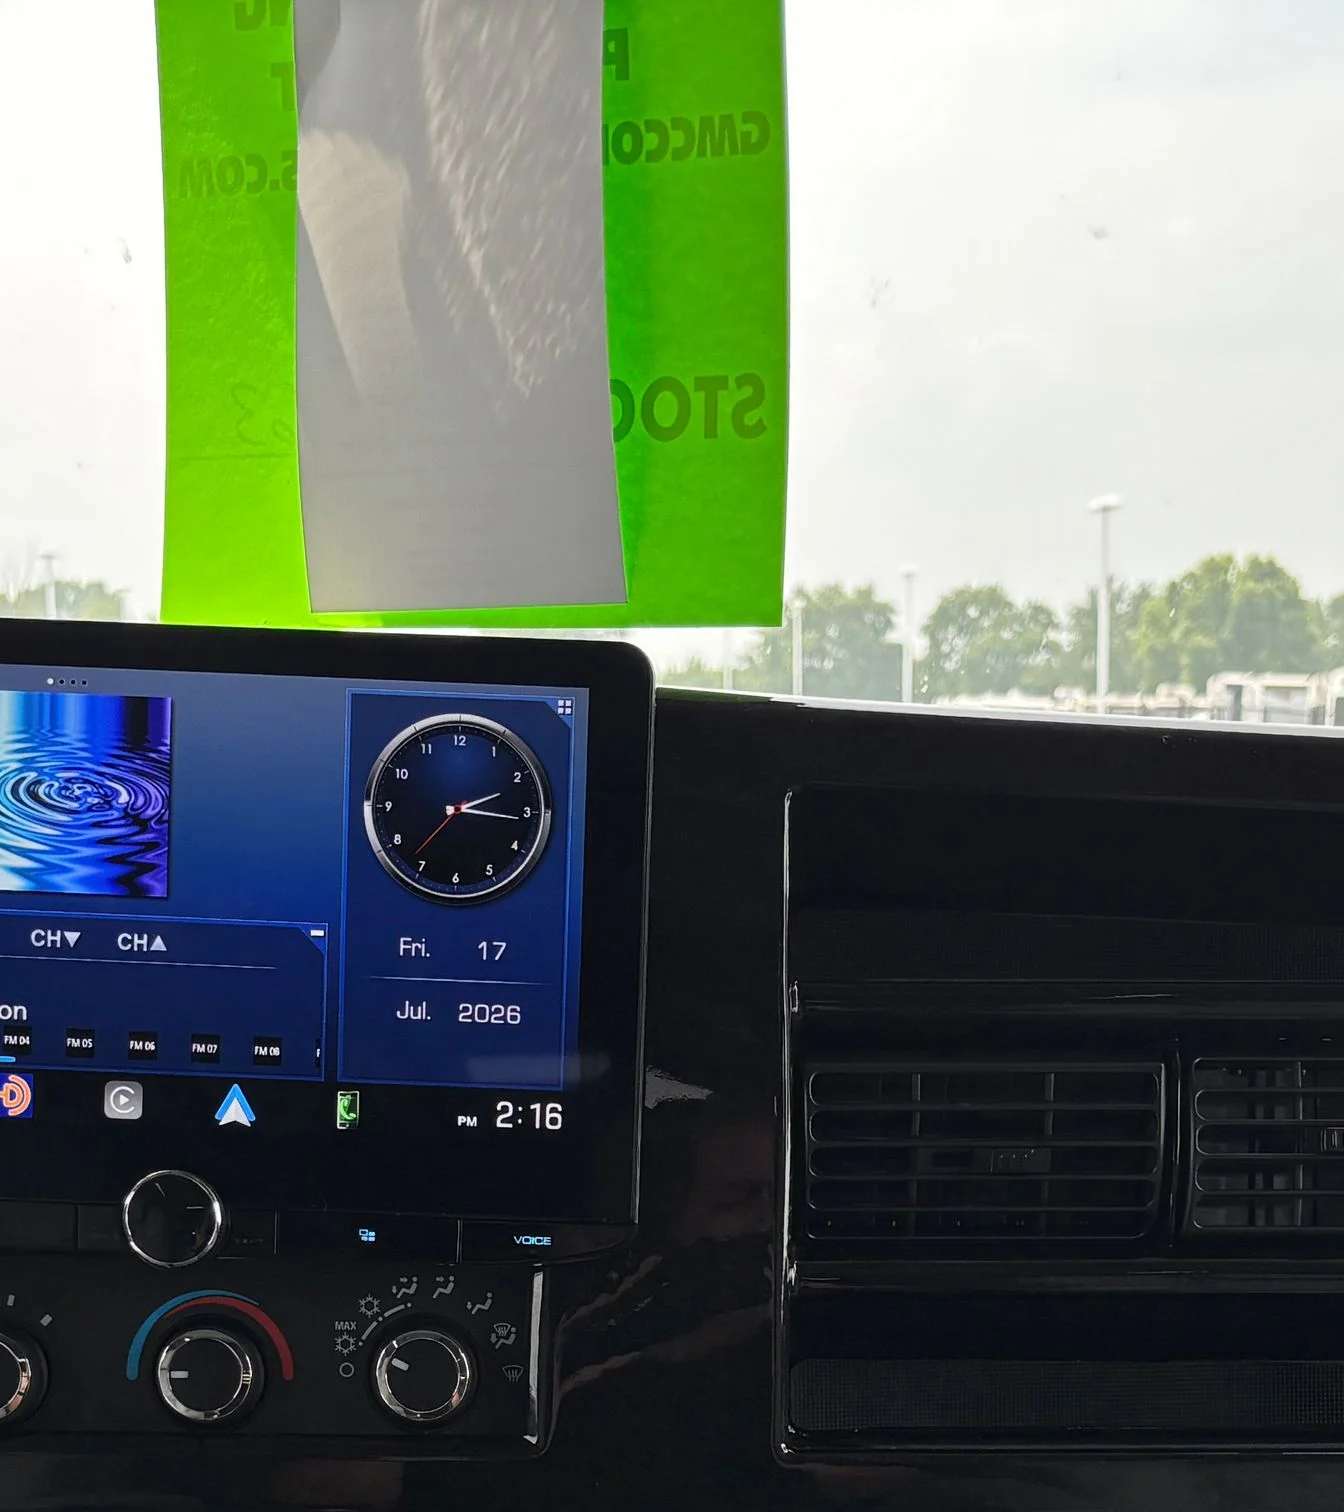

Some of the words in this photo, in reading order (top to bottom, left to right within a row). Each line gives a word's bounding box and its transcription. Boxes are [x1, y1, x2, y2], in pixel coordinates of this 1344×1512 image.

[454, 735, 466, 746] 12
[421, 744, 432, 755] 11
[396, 769, 408, 779] 10
[514, 772, 521, 782] 2
[385, 802, 392, 811] 9
[524, 807, 531, 818] 3
[394, 834, 401, 845] 8
[511, 840, 518, 850] 4
[419, 861, 426, 871] 7
[486, 864, 493, 875] 5
[452, 873, 459, 882] 6
[31, 928, 63, 949] CH
[117, 932, 148, 953] CH
[399, 937, 431, 959] Fri.
[478, 941, 507, 961] 17
[396, 1001, 431, 1022] Jul.
[458, 1003, 521, 1025] 2026
[4, 1034, 18, 1045] FM
[19, 1035, 31, 1046] 04
[66, 1037, 80, 1047] FM
[82, 1038, 93, 1048] 05
[129, 1040, 143, 1050] FM
[144, 1040, 156, 1051] 06
[192, 1043, 206, 1053] FM
[207, 1044, 218, 1054] 07
[254, 1045, 268, 1056] FM
[457, 1115, 478, 1128] PM
[495, 1101, 563, 1131] 2:16
[513, 1235, 552, 1245] VOICE
[335, 1321, 356, 1331] MAX
